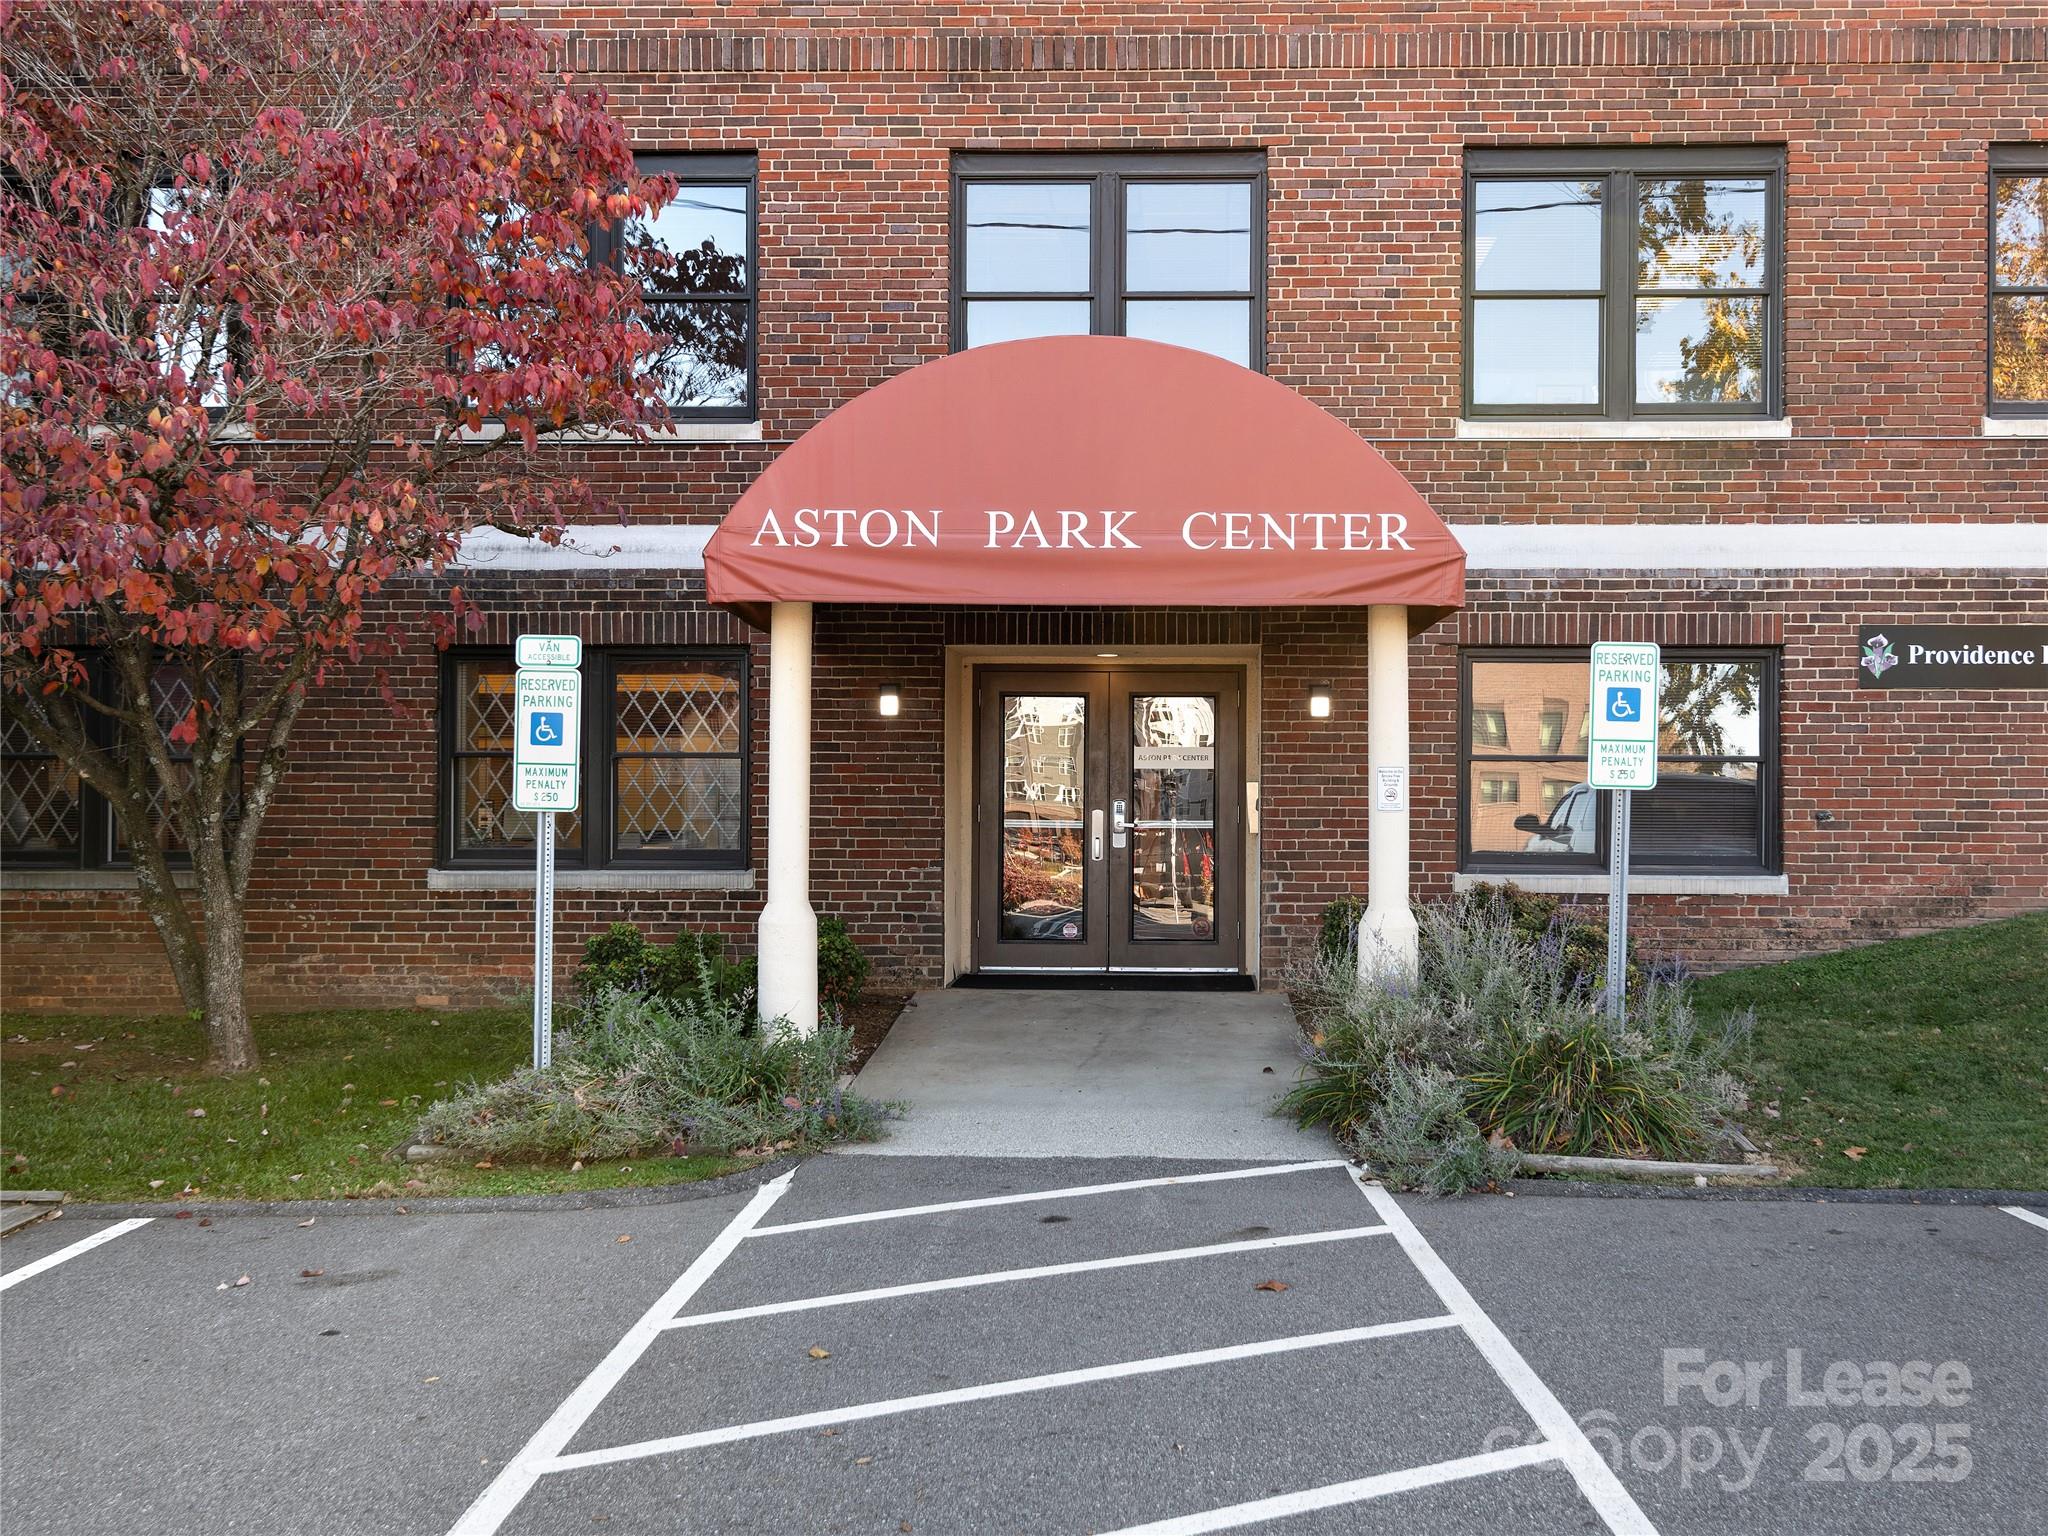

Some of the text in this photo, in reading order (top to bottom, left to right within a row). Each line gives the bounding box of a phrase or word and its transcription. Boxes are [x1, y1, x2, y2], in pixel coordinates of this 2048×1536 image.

[750, 509, 1416, 551] ASTON PARK CENTER
[539, 642, 560, 652] VAN
[527, 653, 570, 661] ACCESSIBLE
[1596, 652, 1654, 666] RESERVED
[1908, 644, 2035, 665] Providence
[1598, 669, 1651, 683] PARKING
[520, 678, 576, 692] RESERVED
[522, 695, 573, 708] PARKING
[1600, 743, 1646, 754] MAXIMUM
[1601, 756, 1644, 767] PENALTY
[525, 767, 568, 777] MAXIMUM
[526, 779, 567, 790] PENALTY
